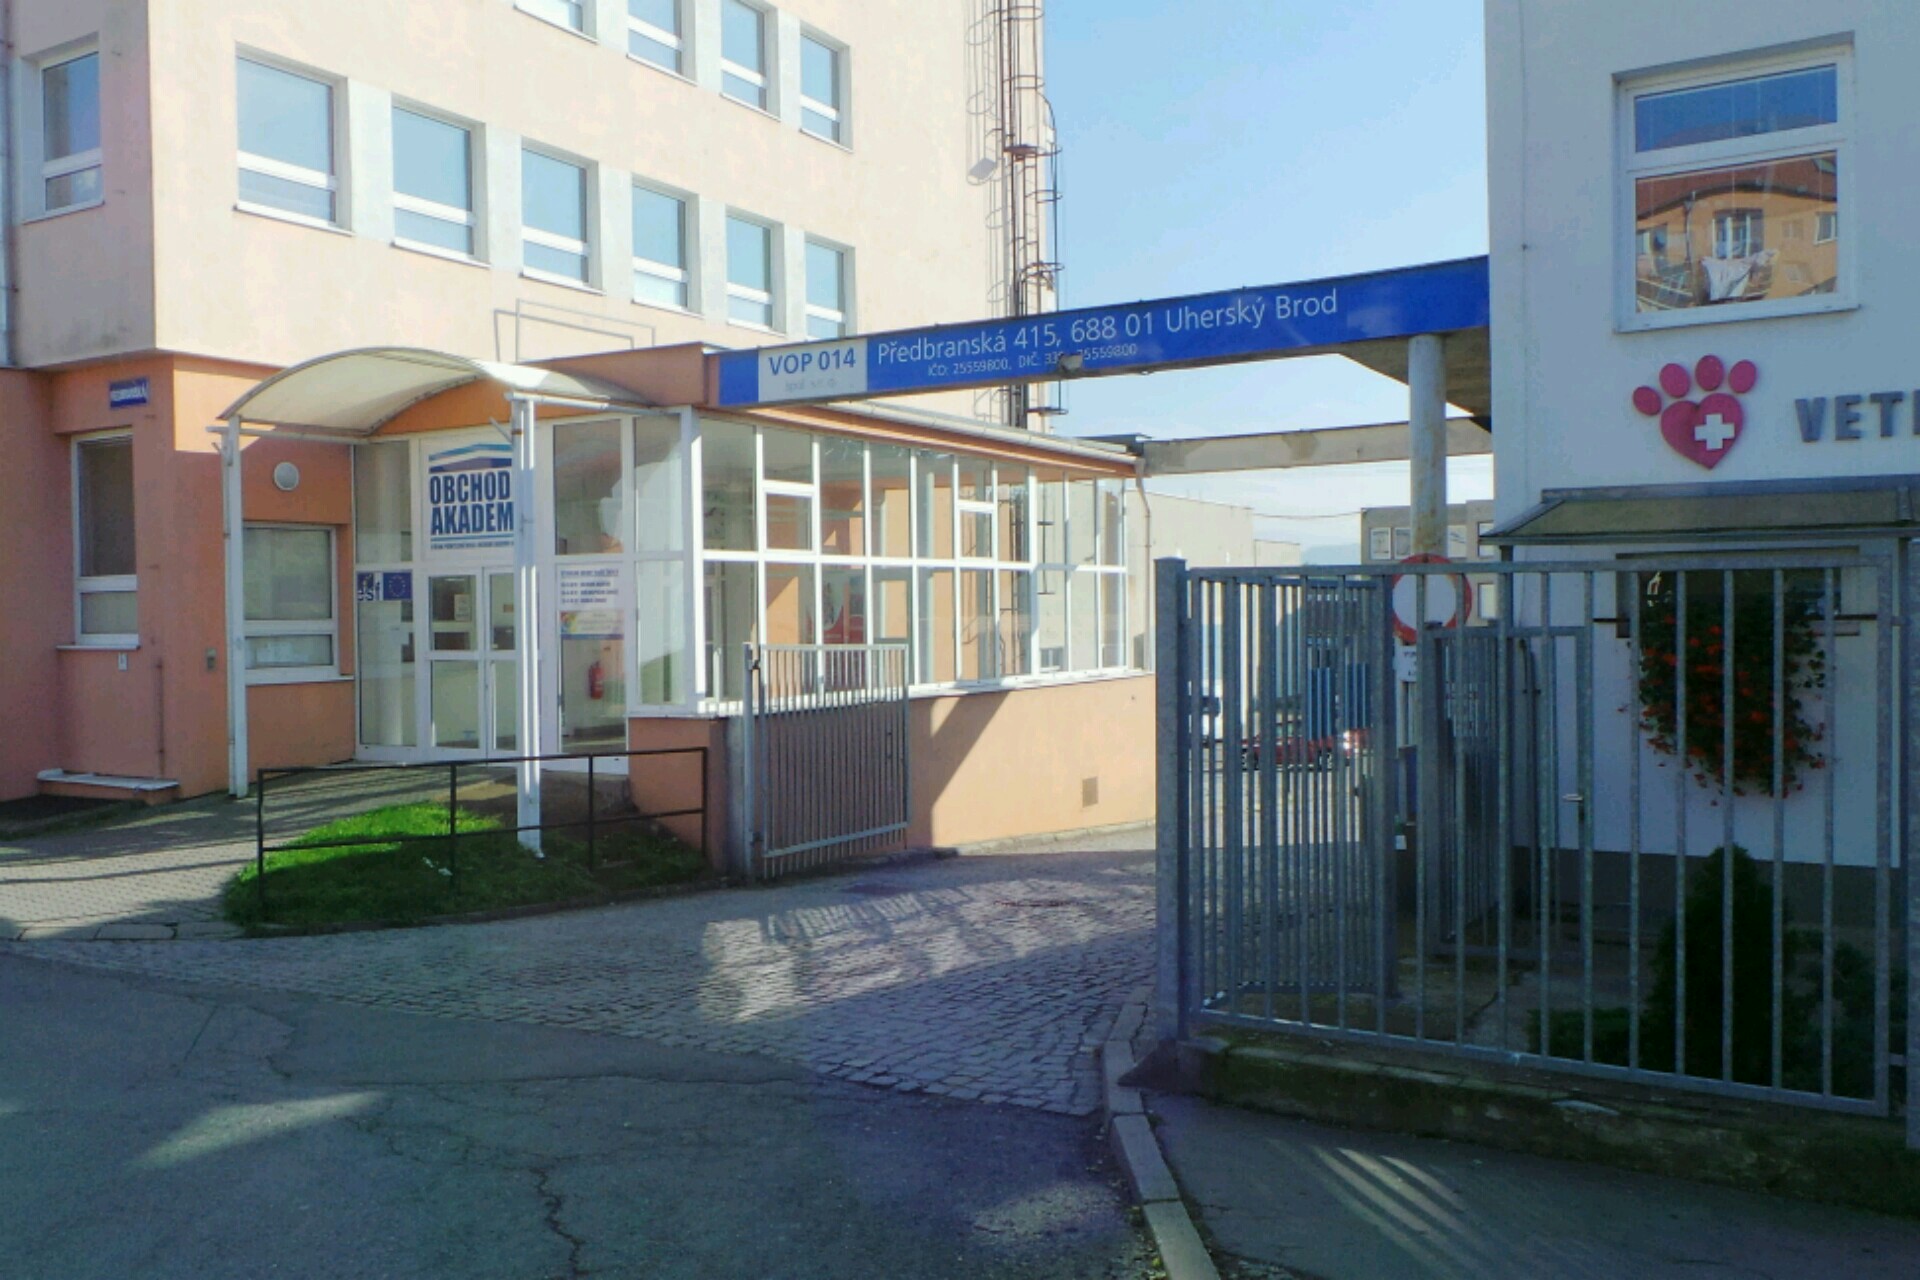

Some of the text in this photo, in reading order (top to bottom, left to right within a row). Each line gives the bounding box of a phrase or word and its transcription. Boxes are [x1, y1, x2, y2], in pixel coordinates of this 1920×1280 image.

[878, 288, 1337, 364] Předbranská 415, 688 01 Uherský Brod
[768, 347, 855, 376] VOP 014
